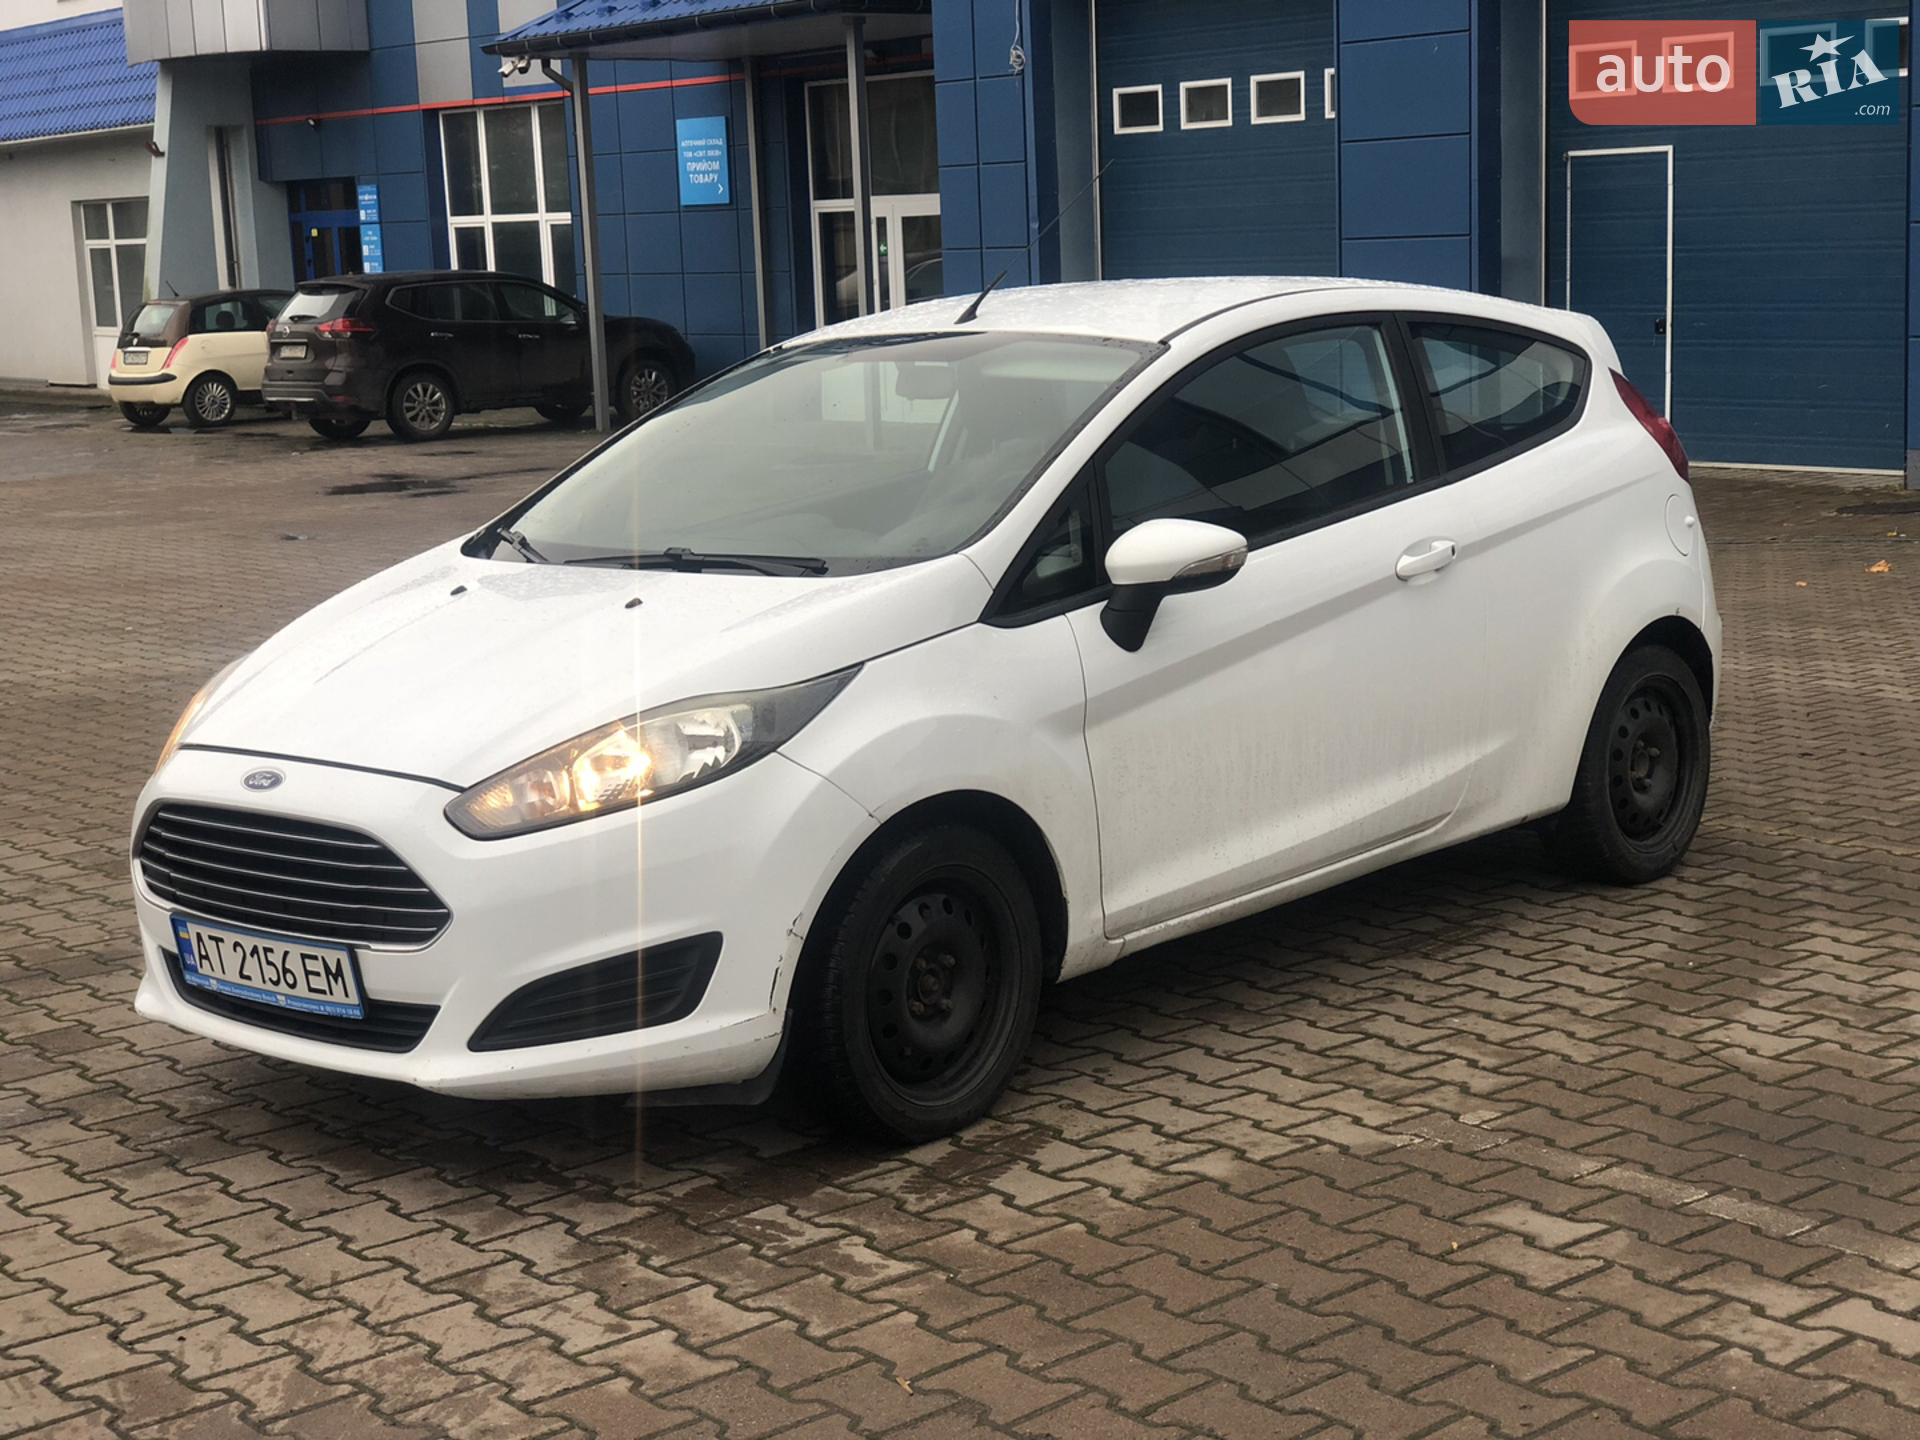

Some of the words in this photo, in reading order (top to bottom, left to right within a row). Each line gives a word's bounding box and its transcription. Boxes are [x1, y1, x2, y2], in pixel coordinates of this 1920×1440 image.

[686, 159, 720, 172] ПРИЙОМ
[689, 173, 718, 184] ТОВАРУ
[195, 931, 226, 975] AT
[233, 941, 297, 989] 2156
[299, 952, 350, 999] EM
